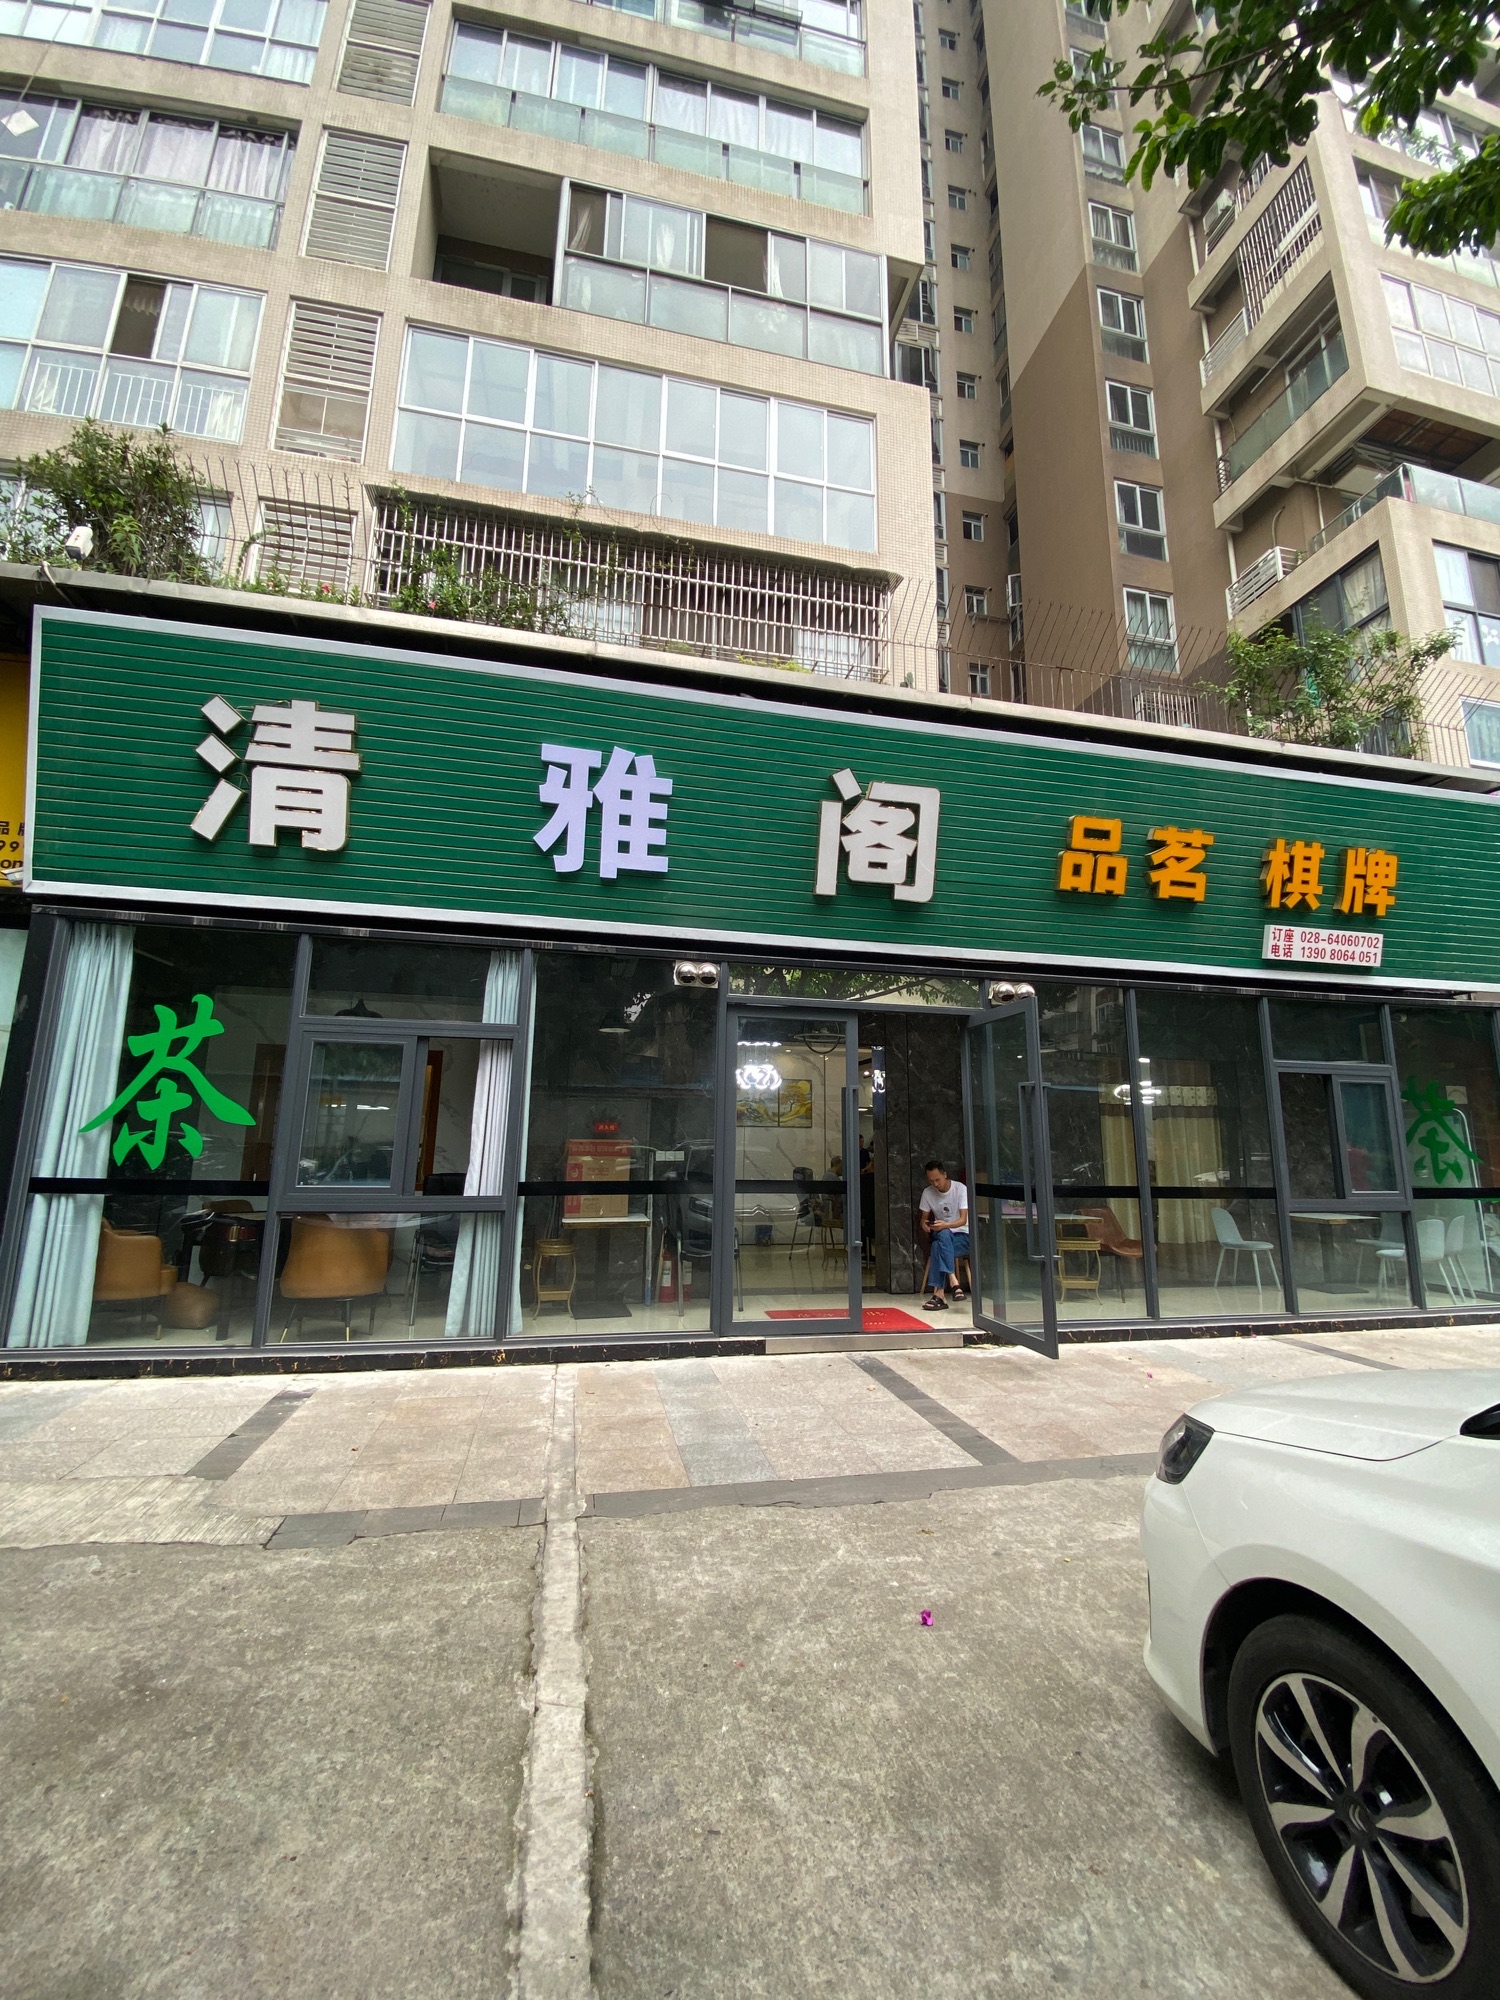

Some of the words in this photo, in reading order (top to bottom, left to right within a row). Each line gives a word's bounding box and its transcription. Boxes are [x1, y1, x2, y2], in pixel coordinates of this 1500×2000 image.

[190, 694, 942, 905] 清雅阁
[1056, 815, 1215, 903] 品茗
[1260, 838, 1399, 917] 棋牌
[1270, 942, 1294, 959] 电话
[1301, 946, 1327, 960] 1390
[1329, 948, 1356, 962] 8064
[1358, 951, 1378, 964] 051
[1271, 927, 1295, 943] 订座
[1300, 931, 1380, 949] 028-64060702
[79, 993, 257, 1171] 茶
